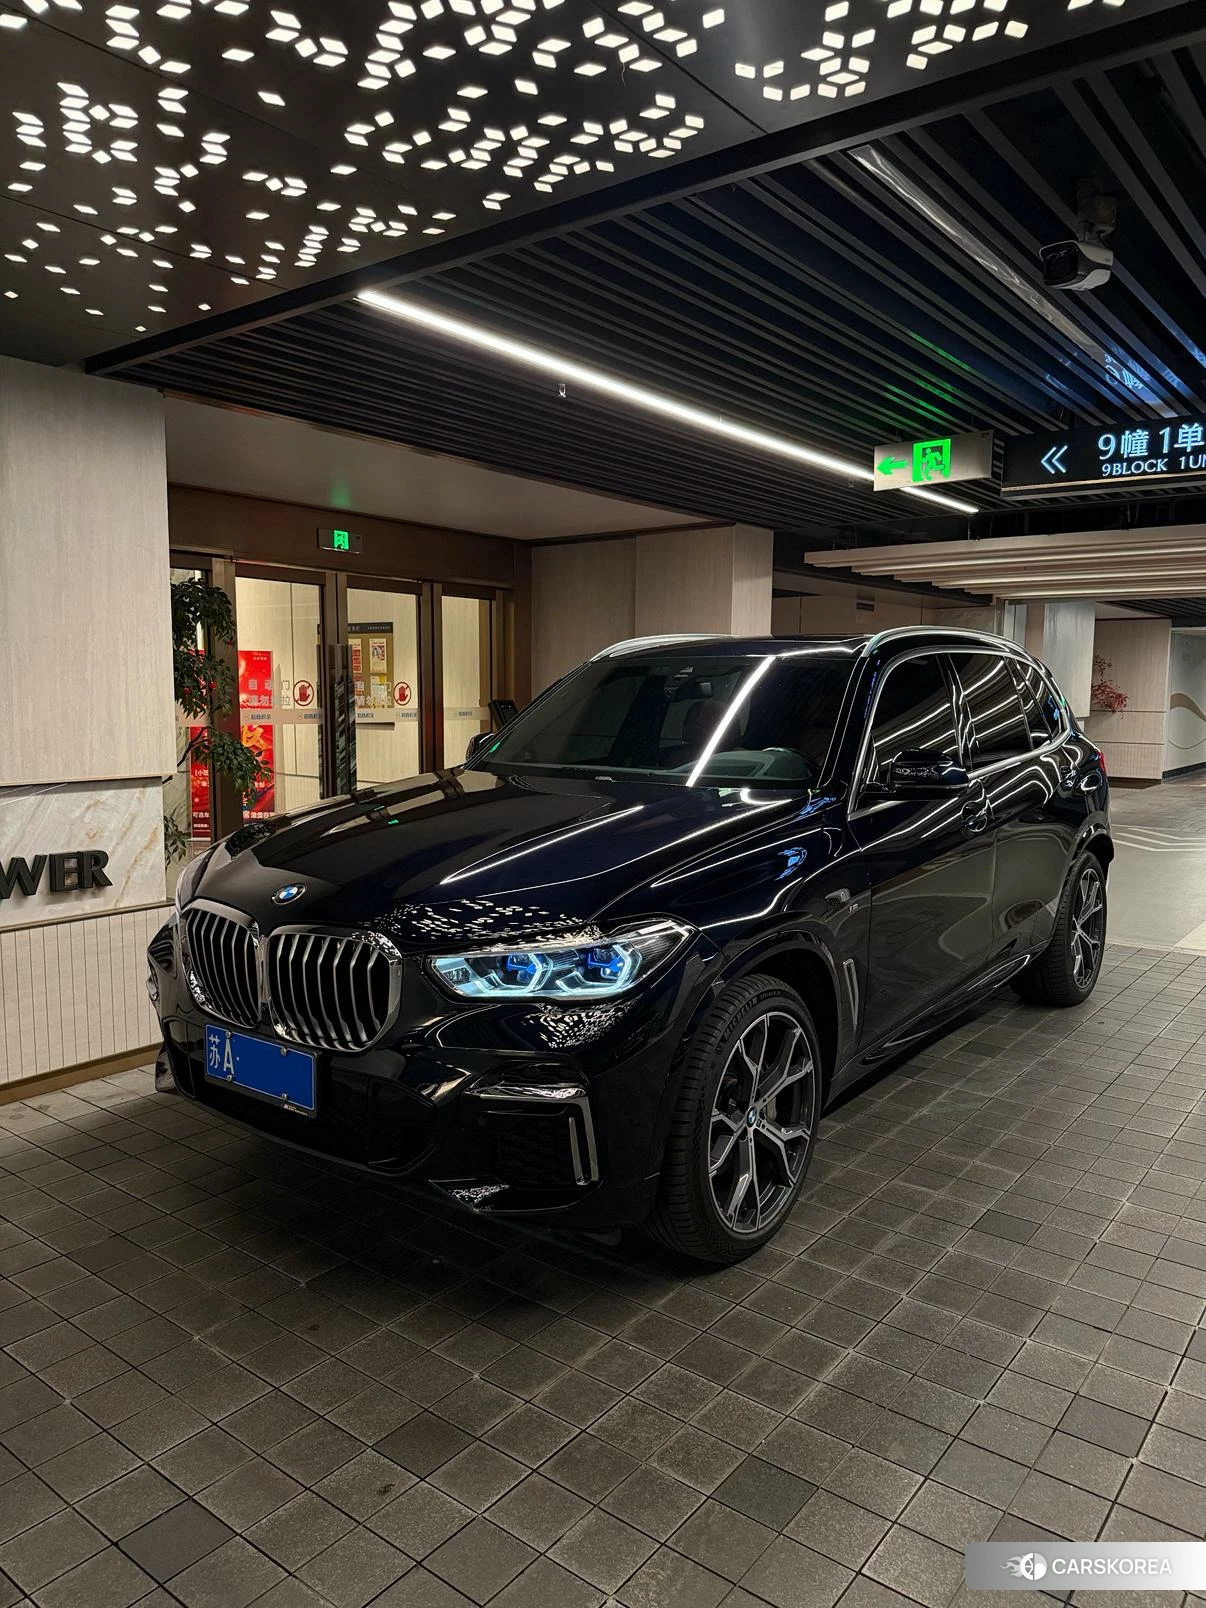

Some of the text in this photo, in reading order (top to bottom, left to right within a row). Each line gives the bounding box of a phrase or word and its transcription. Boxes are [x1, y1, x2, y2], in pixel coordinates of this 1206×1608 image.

[1098, 429, 1150, 460] 9幢
[1102, 458, 1168, 477] 9BLOCK
[0, 850, 113, 899] WER
